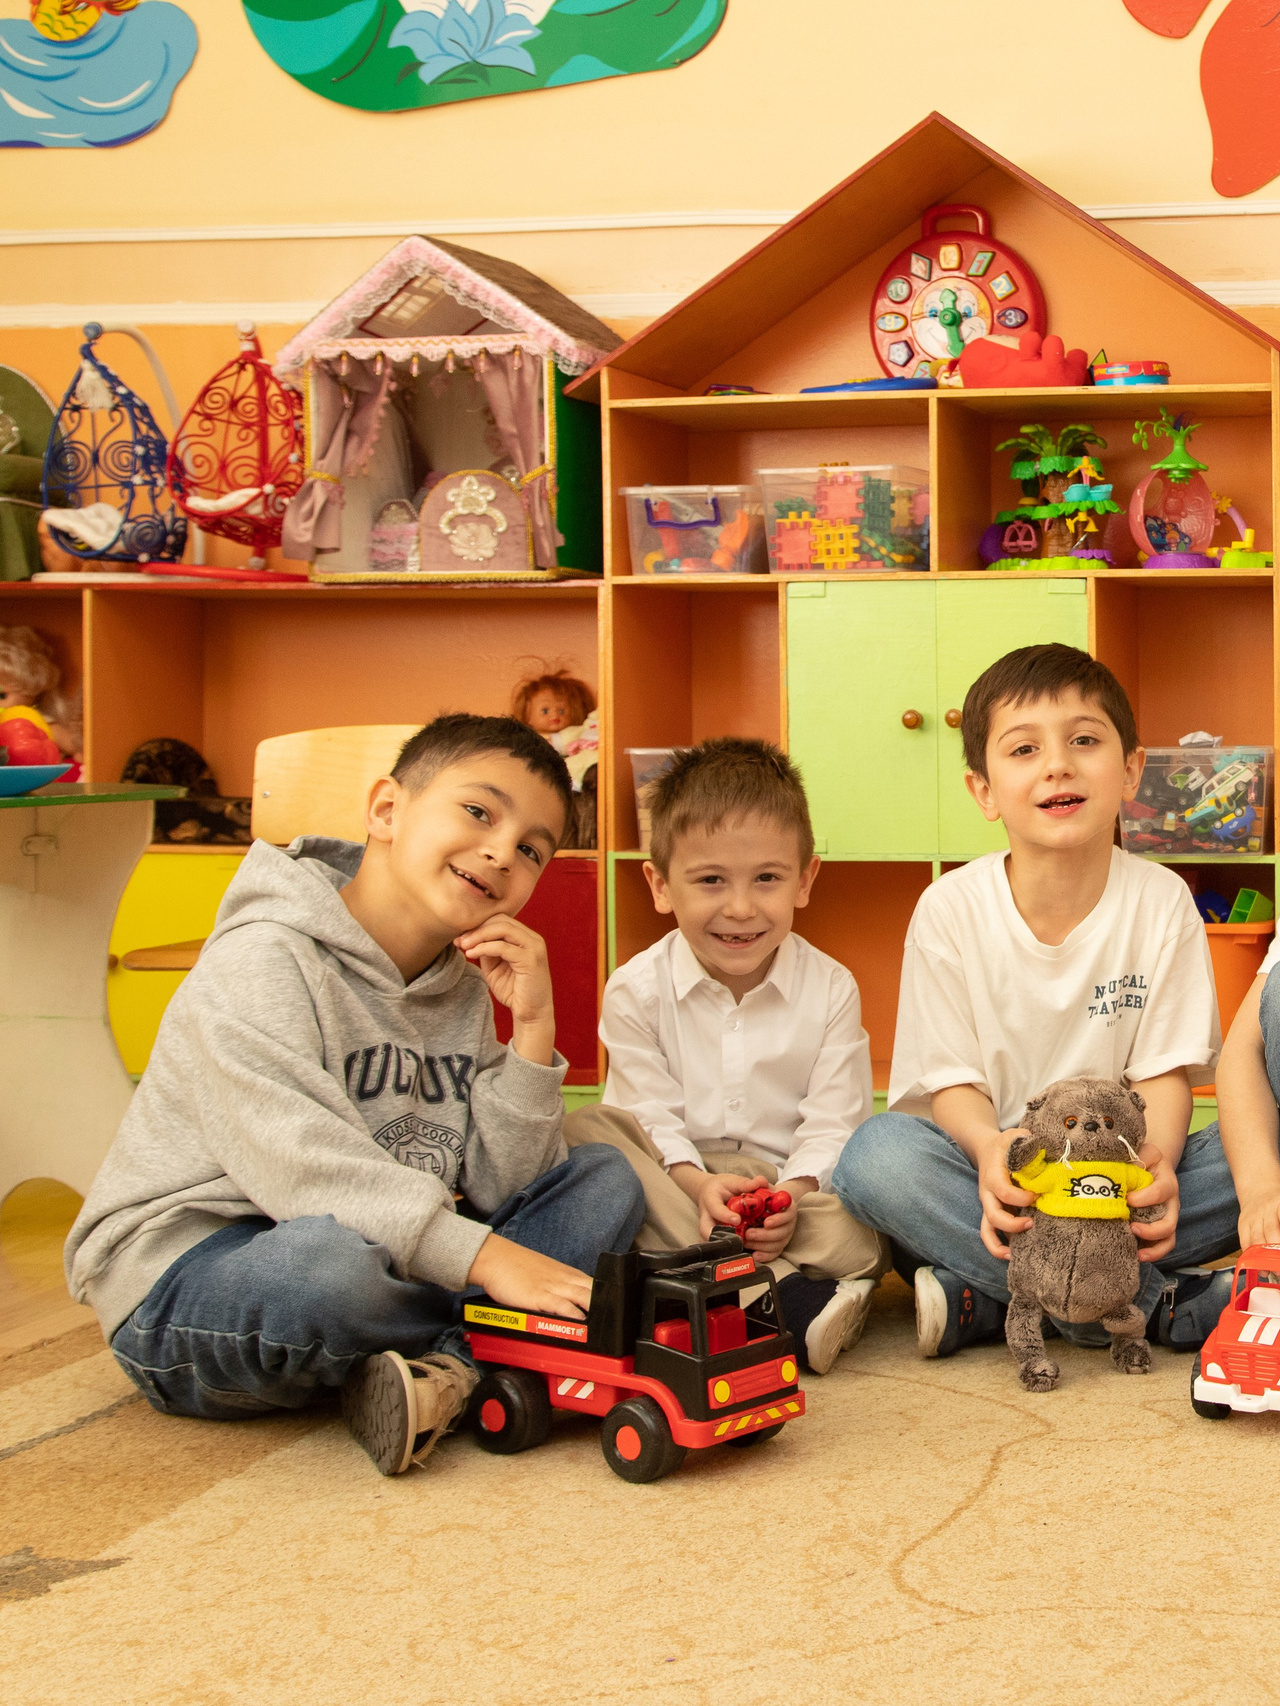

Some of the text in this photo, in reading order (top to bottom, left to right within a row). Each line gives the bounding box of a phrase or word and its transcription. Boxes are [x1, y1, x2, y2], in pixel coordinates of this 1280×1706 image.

[976, 259, 985, 273] 1
[995, 276, 1007, 294] 2
[885, 315, 896, 331] 9
[1004, 309, 1016, 326] 3
[726, 1263, 750, 1275] MAMMOET
[473, 1309, 576, 1336] CONSTRUCTION MAMMOET
